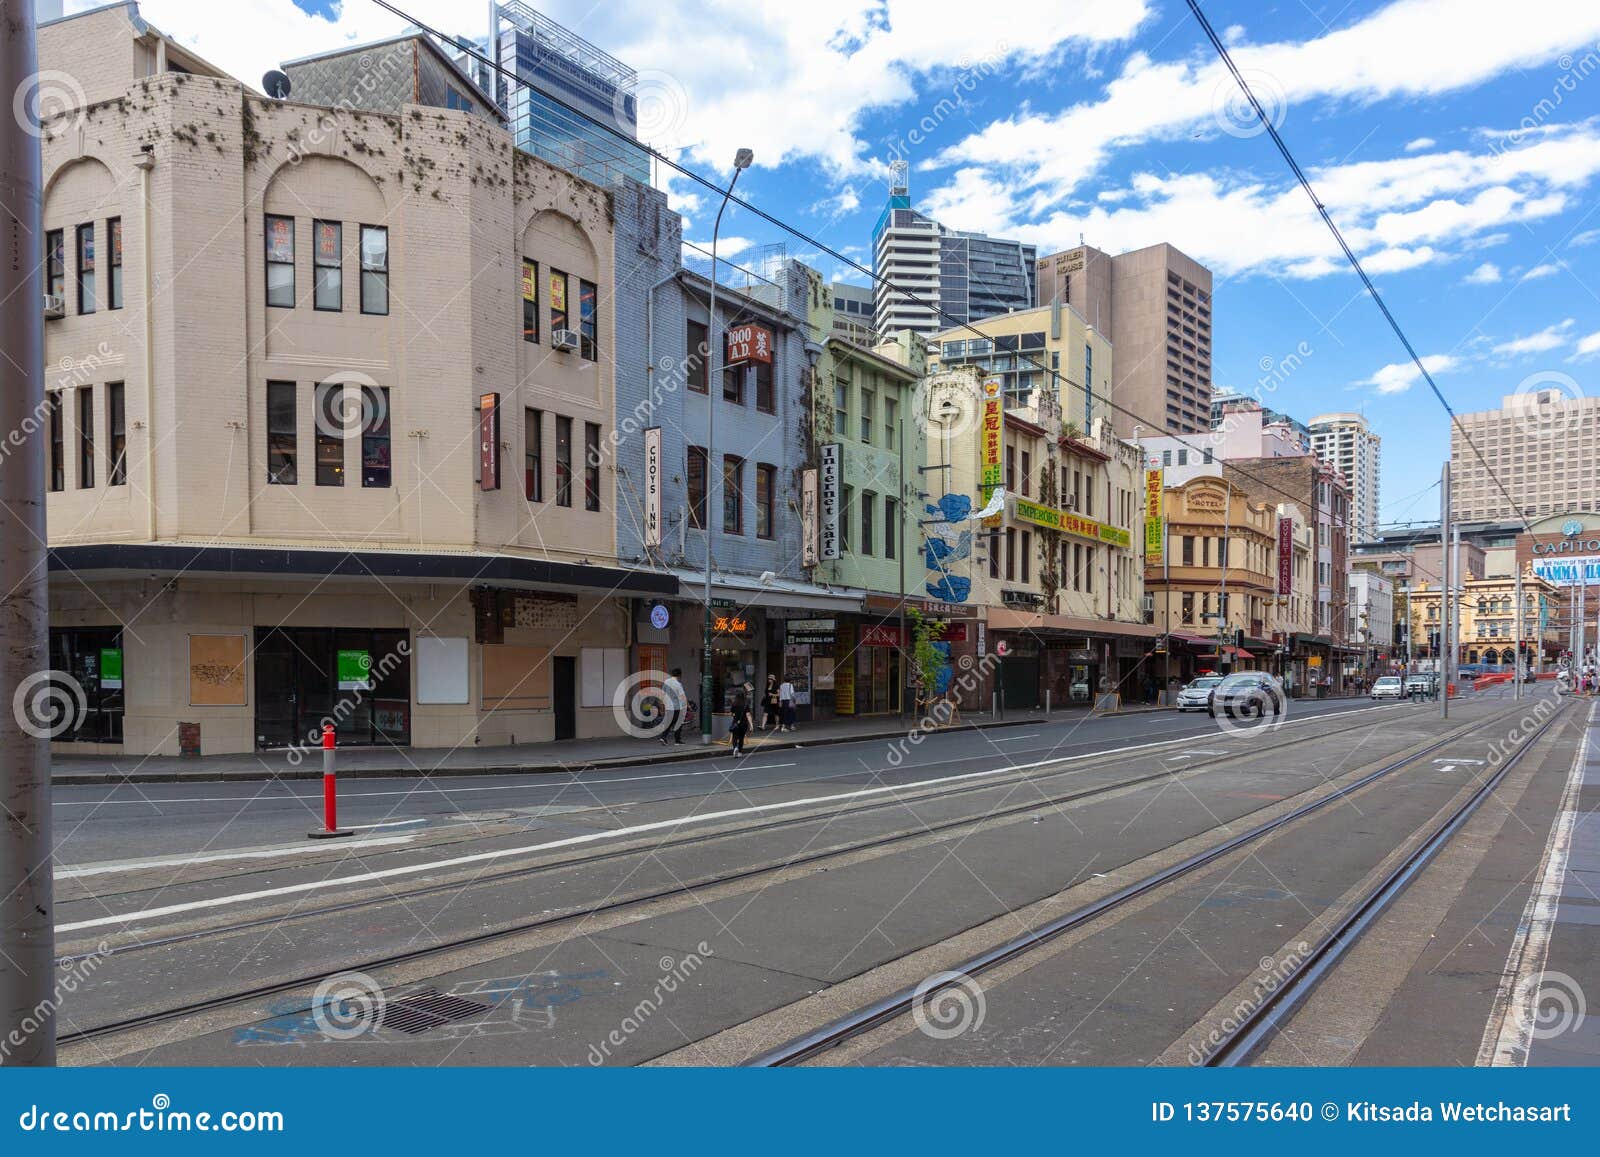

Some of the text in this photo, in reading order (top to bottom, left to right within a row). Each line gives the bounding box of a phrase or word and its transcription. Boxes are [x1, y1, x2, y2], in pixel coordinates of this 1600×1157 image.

[729, 327, 752, 346] 1000
[648, 446, 657, 494] CHOYS
[823, 447, 836, 557] Internet cafe
